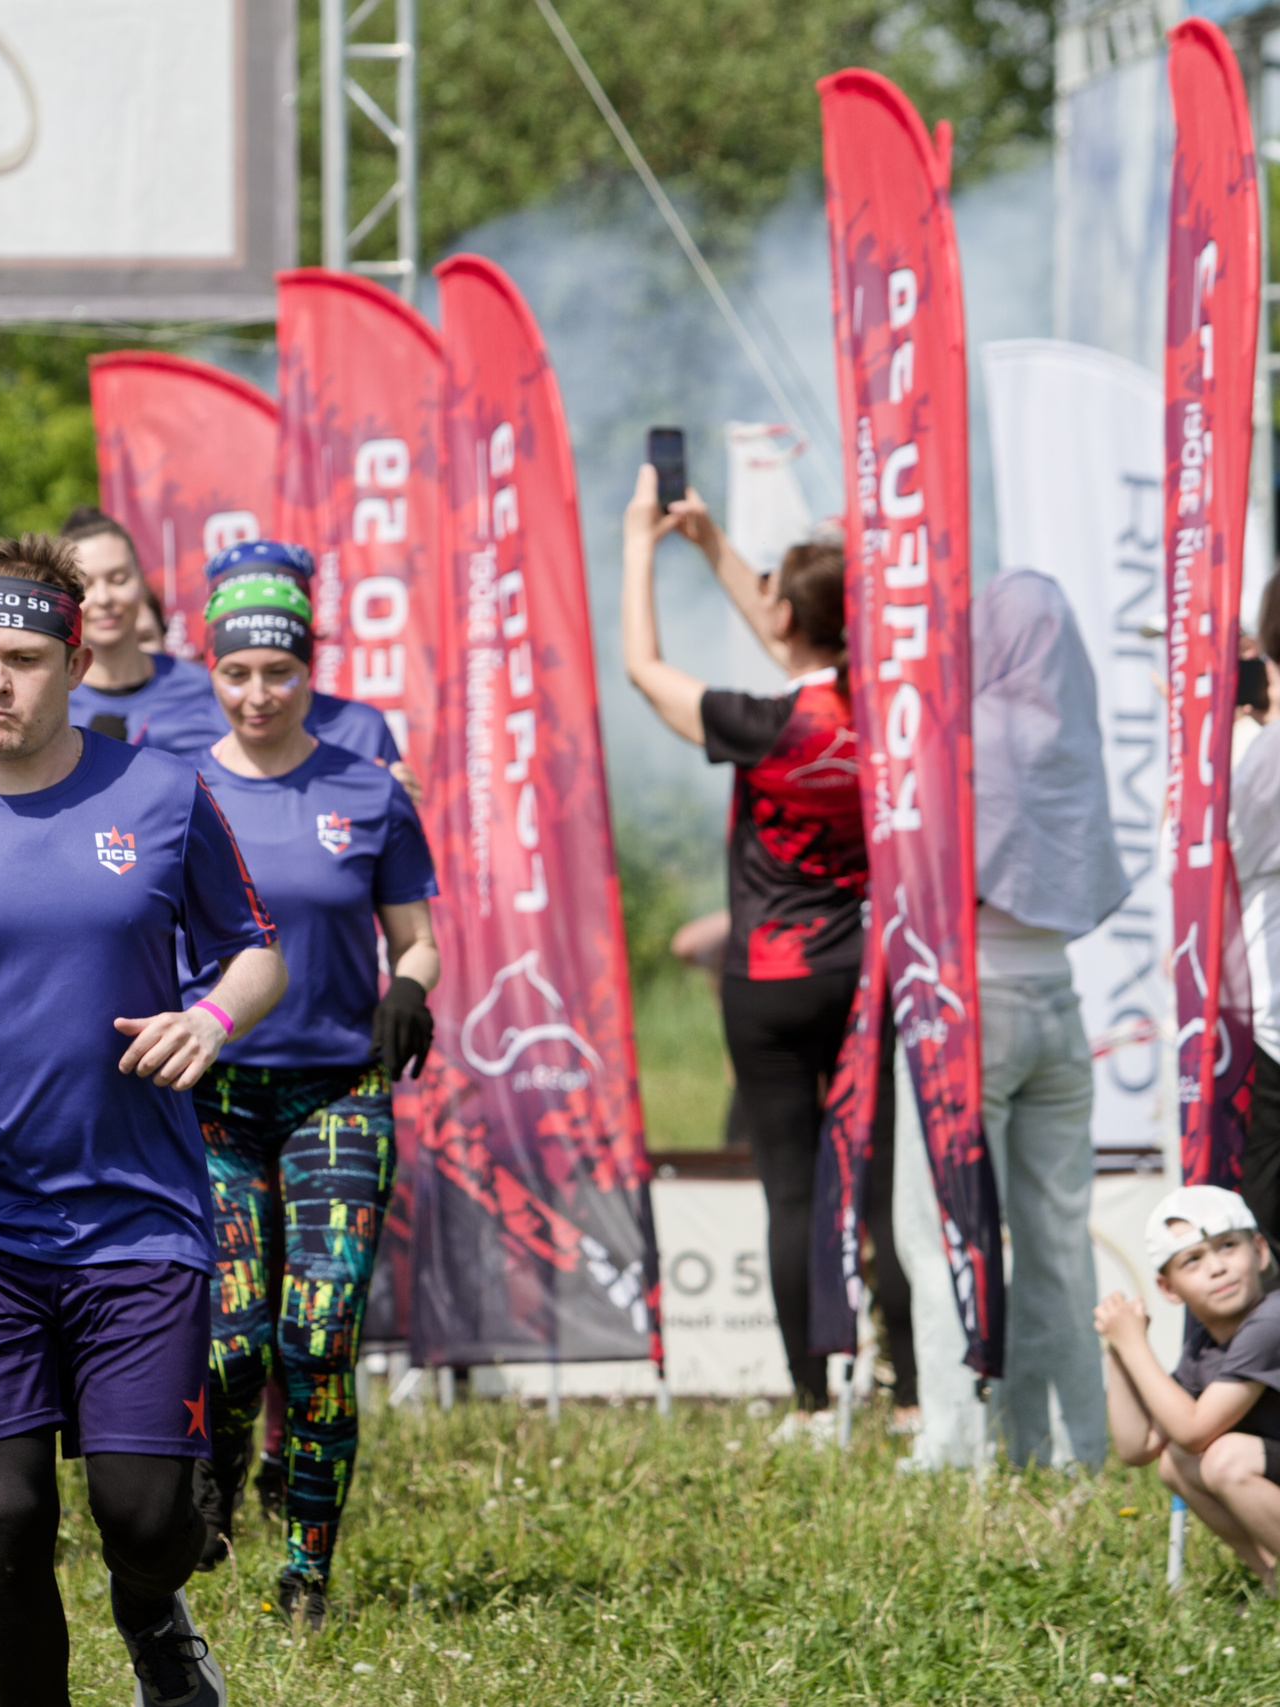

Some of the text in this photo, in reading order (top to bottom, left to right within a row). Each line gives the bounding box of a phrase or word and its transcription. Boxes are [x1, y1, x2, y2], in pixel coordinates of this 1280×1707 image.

[27, 597, 50, 613] 59
[225, 614, 288, 632] РОДЕО
[249, 629, 293, 649] 3212
[96, 848, 137, 862] ПСБ
